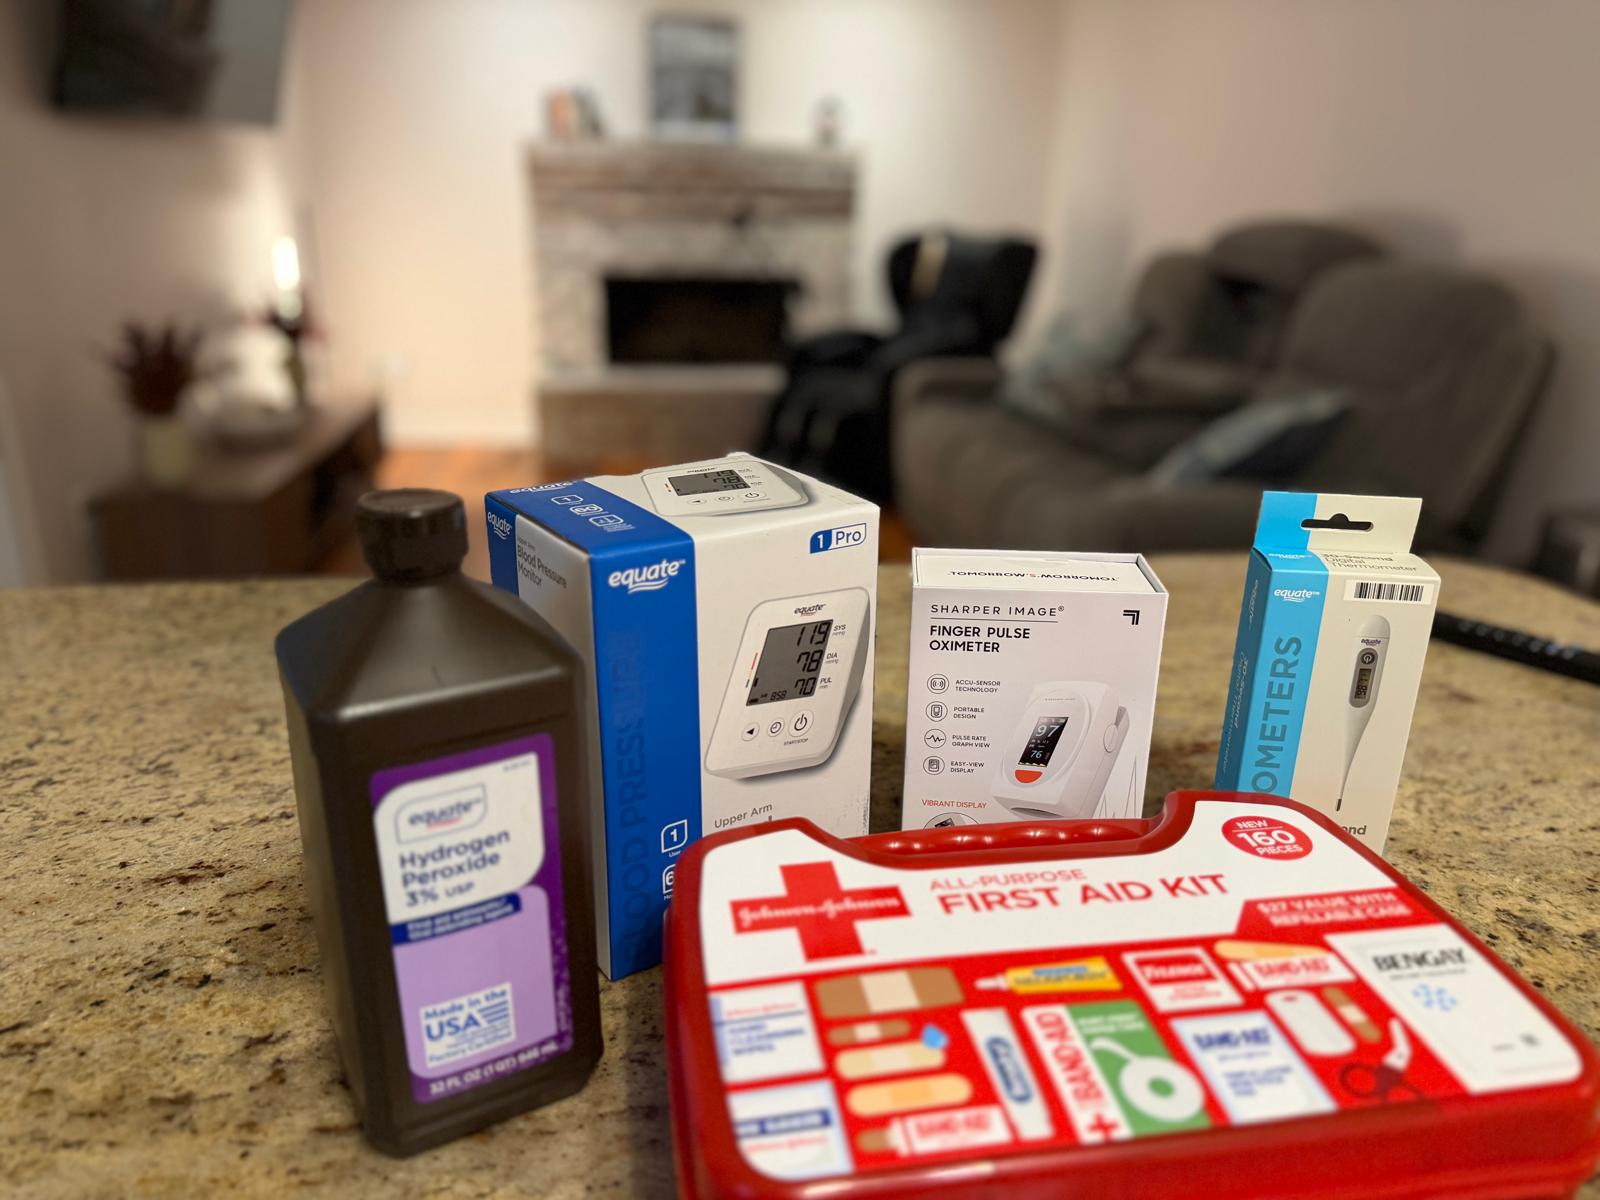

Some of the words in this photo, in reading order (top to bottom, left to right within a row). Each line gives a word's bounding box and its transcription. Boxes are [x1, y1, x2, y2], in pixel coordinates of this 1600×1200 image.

[488, 512, 512, 537] equate
[817, 535, 825, 549] 1
[835, 530, 862, 545] Pro
[518, 545, 536, 568] Blood
[537, 558, 567, 589] Pressure
[518, 563, 542, 587] Monitor
[608, 558, 685, 592] equate
[1332, 562, 1416, 571] Thermometer
[1274, 588, 1320, 602] equate
[794, 604, 825, 615] equate
[931, 604, 1000, 615] SHARPER
[796, 621, 831, 646] 119
[930, 625, 980, 638] FINGER
[987, 626, 1030, 639] PULSE
[929, 640, 1000, 653] OXIMETER
[797, 649, 823, 672] 78
[795, 677, 817, 695] 70
[955, 679, 1001, 687] ACCU-SENSOR
[1251, 637, 1302, 793] OMETERS
[1035, 725, 1060, 738] 97
[1030, 750, 1043, 759] 76
[409, 796, 482, 826] equate
[921, 799, 955, 808] VIBRANT
[955, 801, 987, 809] DISPLAY
[714, 811, 748, 829] Upper
[751, 803, 773, 817] Arm
[1236, 820, 1268, 829] NEW
[399, 829, 511, 869] Hydrogen
[1236, 830, 1296, 847] 160
[1256, 844, 1304, 855] PIECES
[402, 853, 500, 888] Peroxide
[930, 869, 1086, 891] ALL-PURPOSE
[405, 887, 439, 908] 3%
[444, 881, 475, 899] USP
[937, 886, 1060, 915] FIRST
[1080, 881, 1153, 905] AID
[1159, 874, 1229, 898] KIT
[1289, 895, 1349, 910] VALUE
[1349, 891, 1398, 904] WITH
[1269, 908, 1368, 927] REFILLABLE
[1367, 903, 1413, 918] CASE
[1372, 948, 1467, 972] BENGAY
[424, 1003, 464, 1018] Made
[468, 997, 481, 1007] in
[484, 989, 507, 1002] the
[425, 1013, 480, 1041] USA
[446, 1076, 462, 1089] FL
[463, 1069, 483, 1084] OZ
